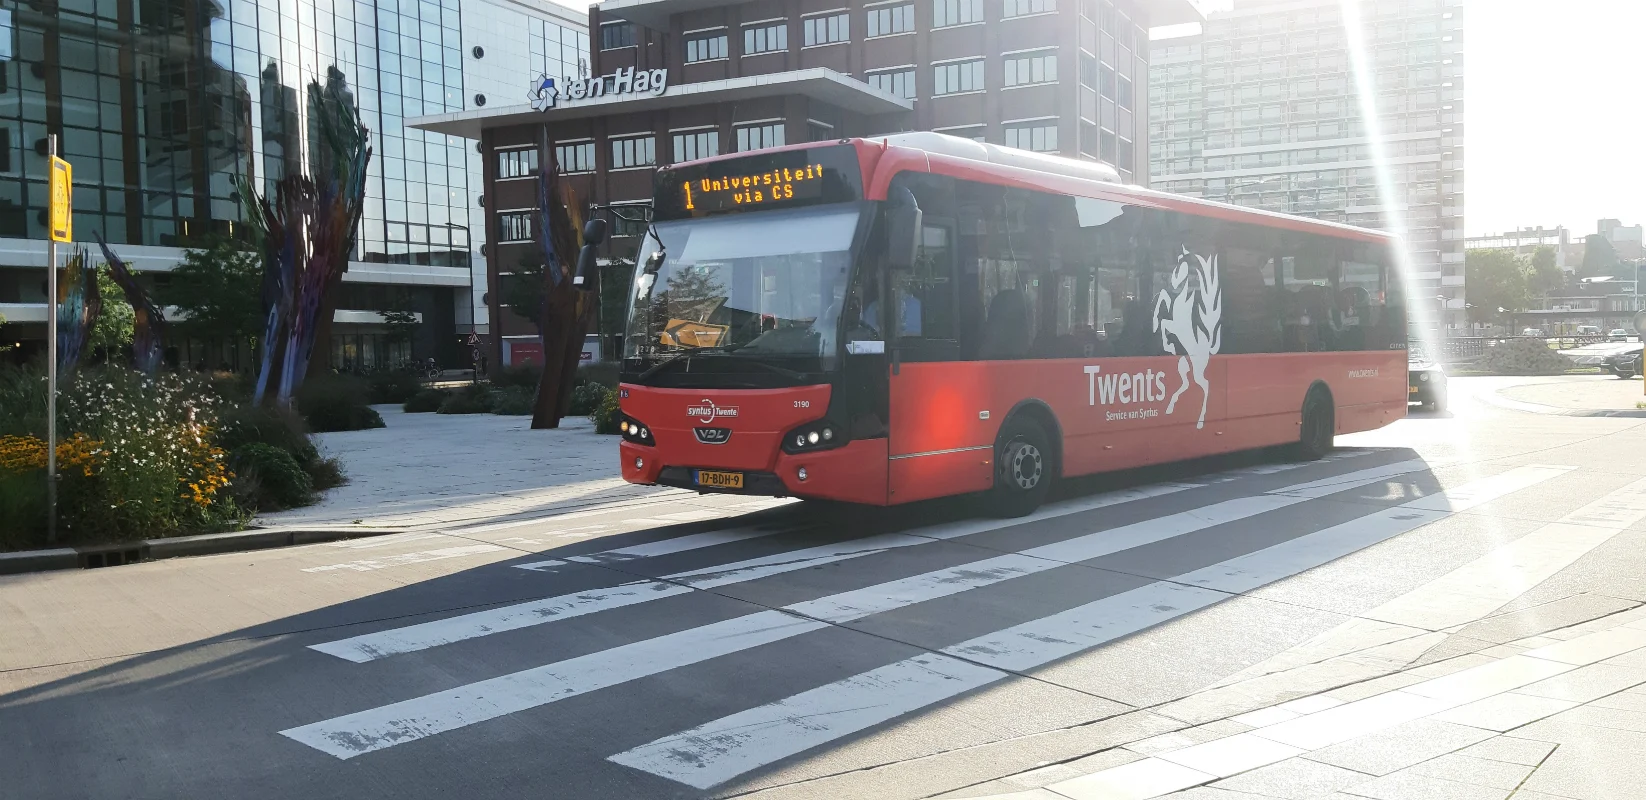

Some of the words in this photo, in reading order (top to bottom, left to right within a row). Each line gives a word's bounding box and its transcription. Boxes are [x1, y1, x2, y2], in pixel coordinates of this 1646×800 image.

[561, 76, 604, 100] ten
[613, 66, 668, 96] Hag
[684, 181, 695, 209] 1
[701, 163, 823, 192] Universiteit
[733, 188, 763, 204] via
[772, 184, 793, 200] CS
[1084, 365, 1166, 406] Twents
[688, 406, 711, 415] syntus
[716, 407, 737, 416] Twente
[1106, 410, 1127, 421] Service
[1140, 408, 1158, 419] Syntus
[699, 429, 725, 439] VDL
[701, 472, 740, 486] 17-BDH-9
